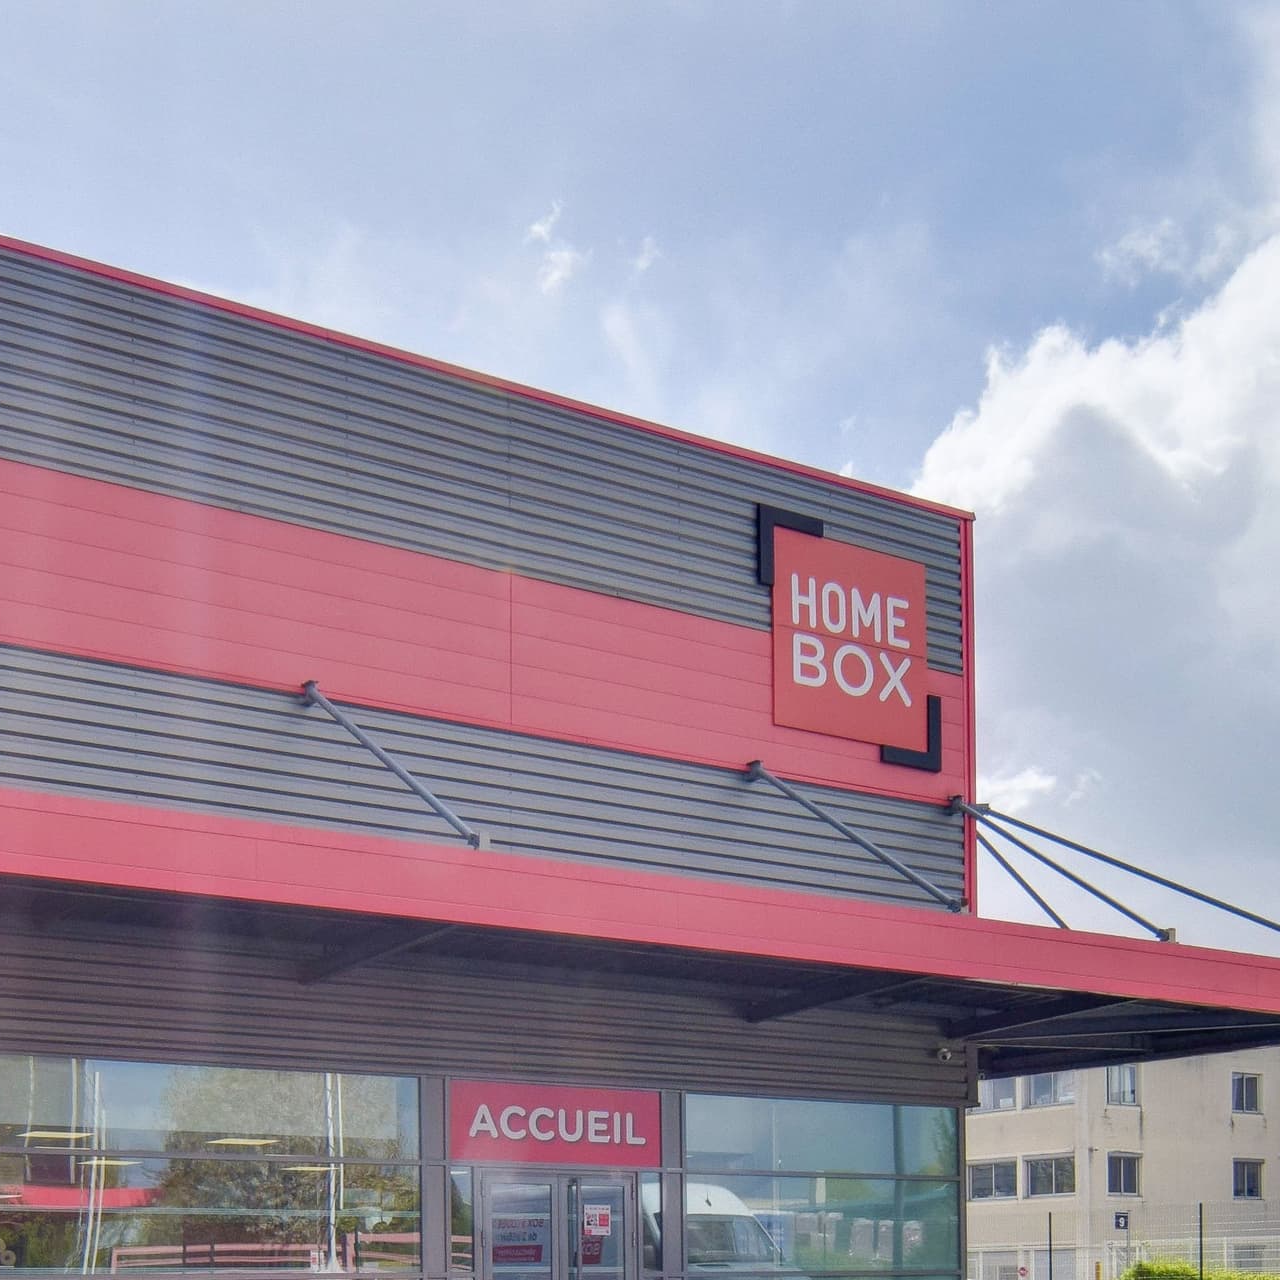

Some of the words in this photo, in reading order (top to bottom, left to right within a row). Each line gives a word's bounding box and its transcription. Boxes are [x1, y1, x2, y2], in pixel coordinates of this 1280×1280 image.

[791, 573, 910, 649] HOME
[793, 632, 912, 707] BOX
[469, 1104, 646, 1145] ACCUEIL
[1119, 1217, 1125, 1227] 9
